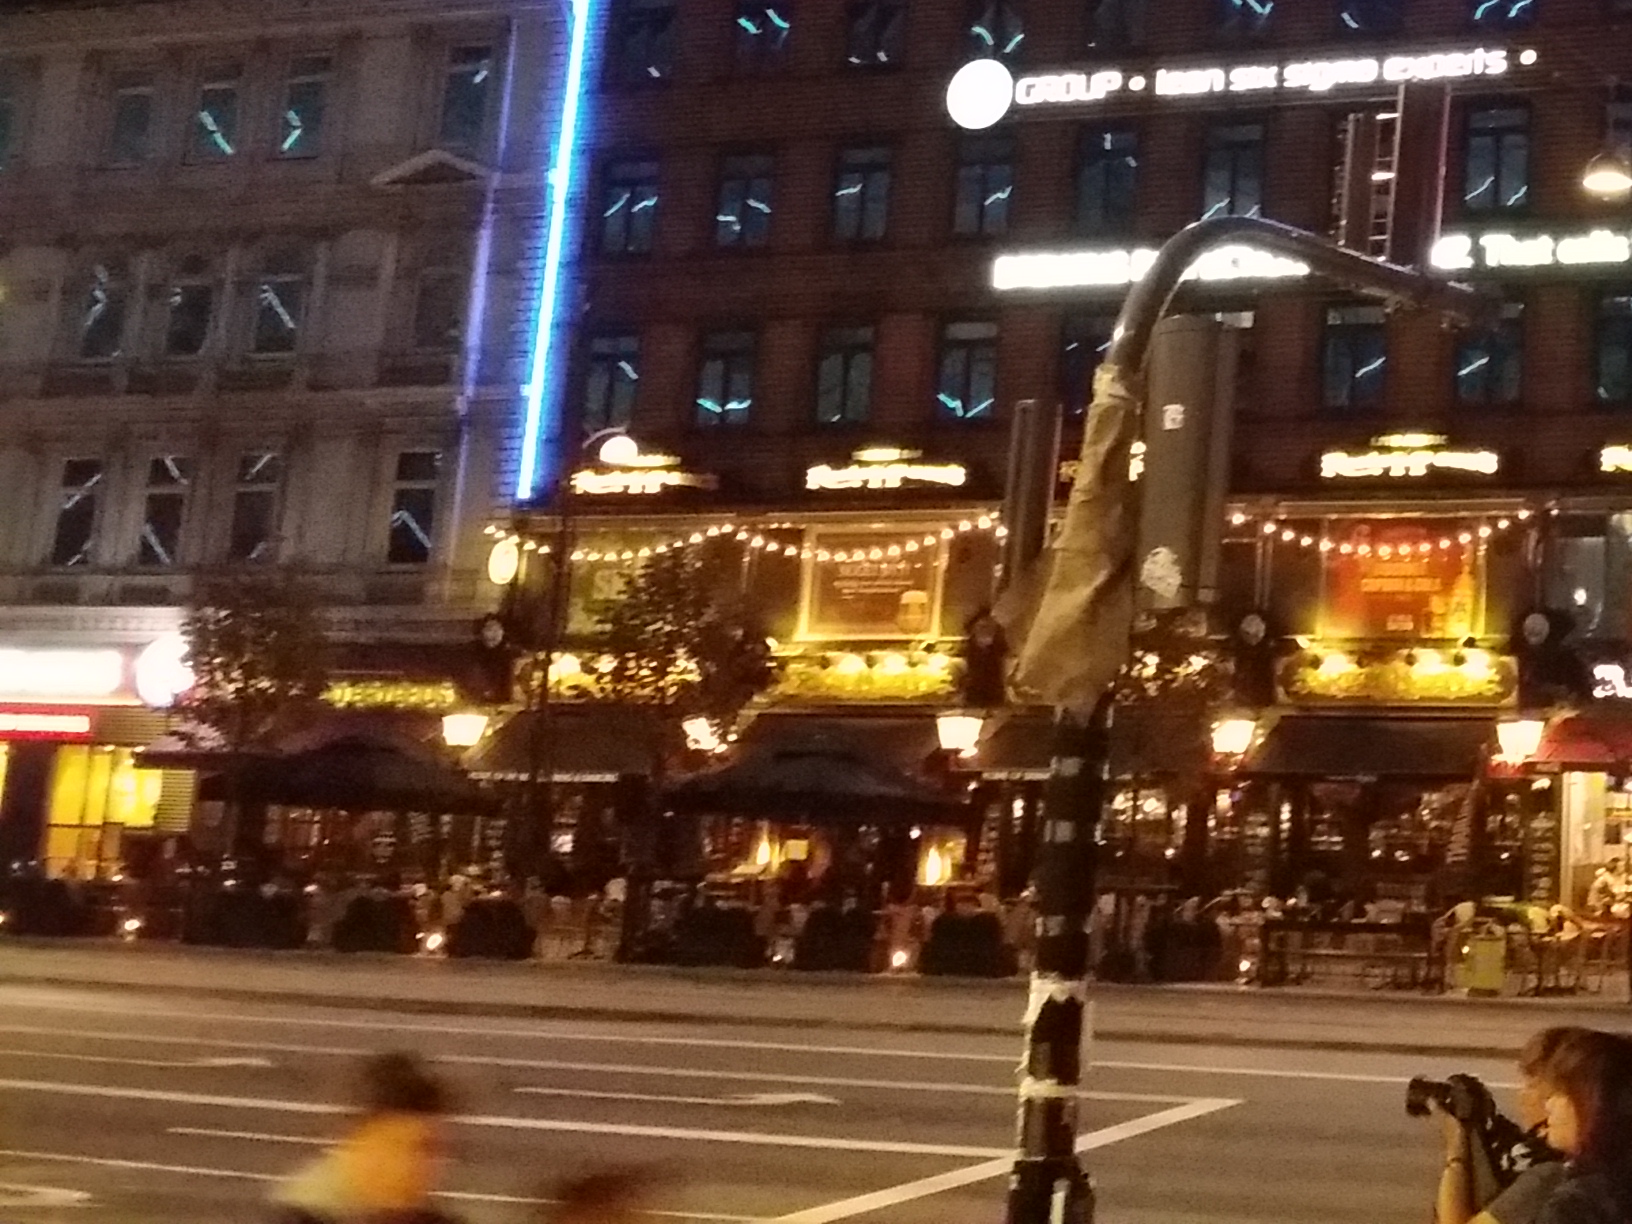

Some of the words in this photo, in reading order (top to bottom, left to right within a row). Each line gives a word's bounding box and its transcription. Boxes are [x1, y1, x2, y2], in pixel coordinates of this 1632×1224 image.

[1015, 71, 1122, 105] GROUP
[1229, 65, 1279, 91] six
[1283, 57, 1379, 92] sigma
[1383, 47, 1508, 81] experts
